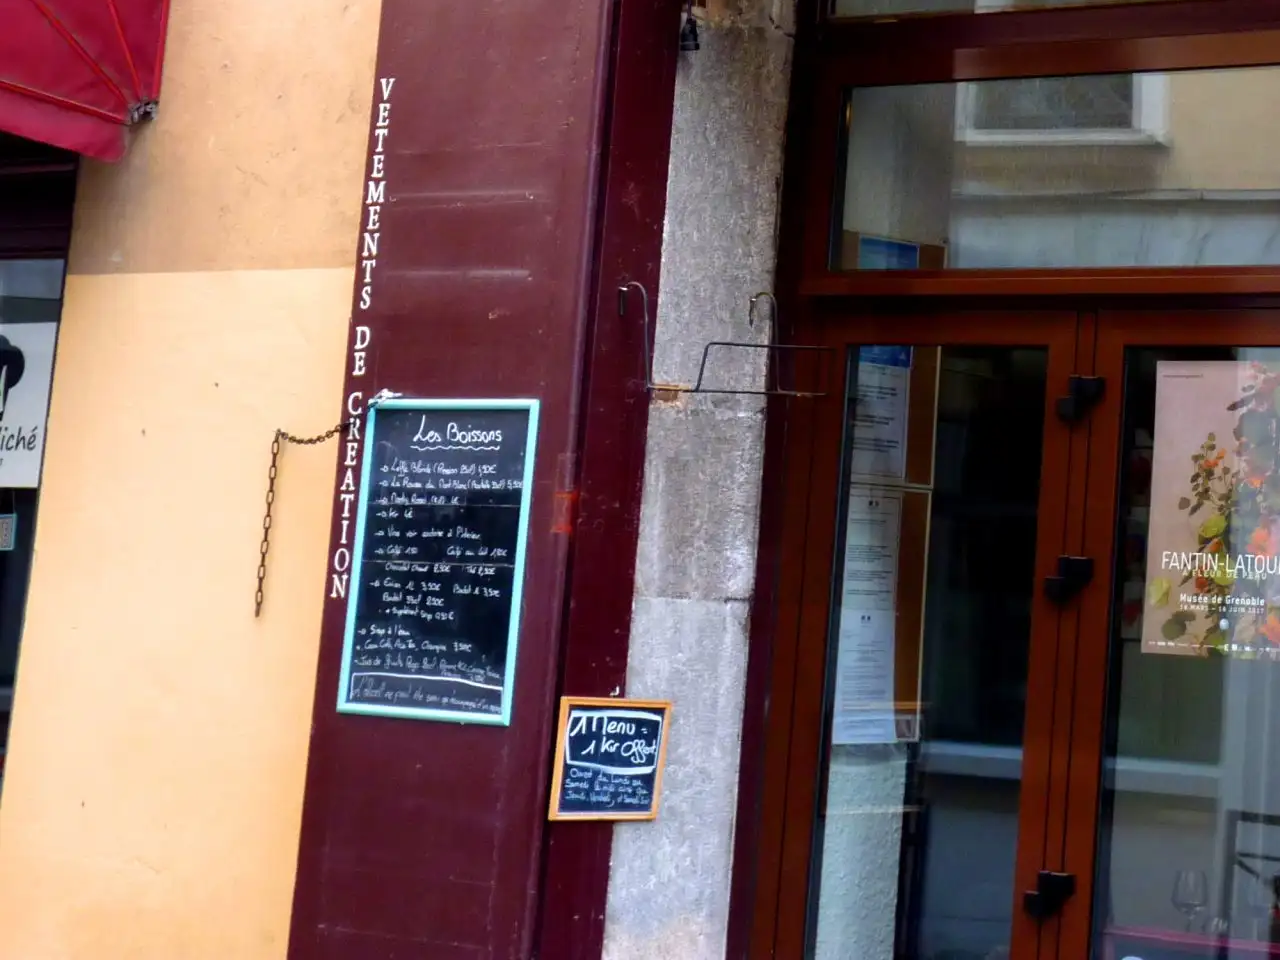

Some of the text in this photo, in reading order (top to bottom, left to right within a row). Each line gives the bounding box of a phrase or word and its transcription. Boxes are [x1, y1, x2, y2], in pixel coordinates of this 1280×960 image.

[330, 77, 396, 598] VETEMENTS DE CREATION
[413, 415, 502, 443] Les Boissons
[1180, 592, 1265, 606] Musée de Grenoble
[592, 716, 636, 735] Menu
[581, 740, 596, 755] 1
